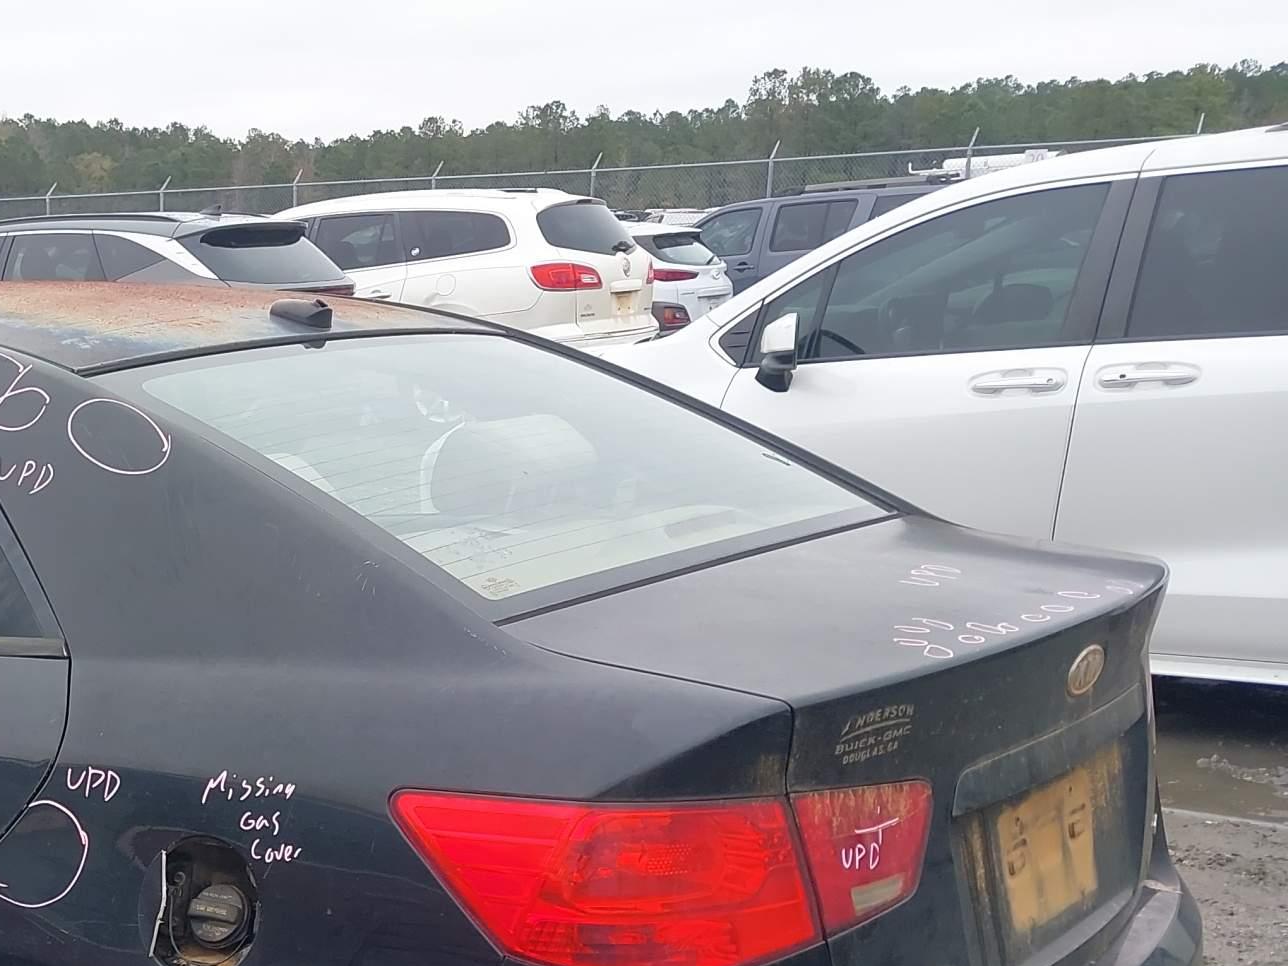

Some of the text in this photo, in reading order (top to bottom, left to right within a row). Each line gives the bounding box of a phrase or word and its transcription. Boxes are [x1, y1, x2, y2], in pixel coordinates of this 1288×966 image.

[66, 766, 122, 802] UPD
[201, 769, 296, 804] Missing
[239, 811, 281, 836] Gas
[251, 838, 302, 863] Cover
[841, 841, 881, 870] UPD
